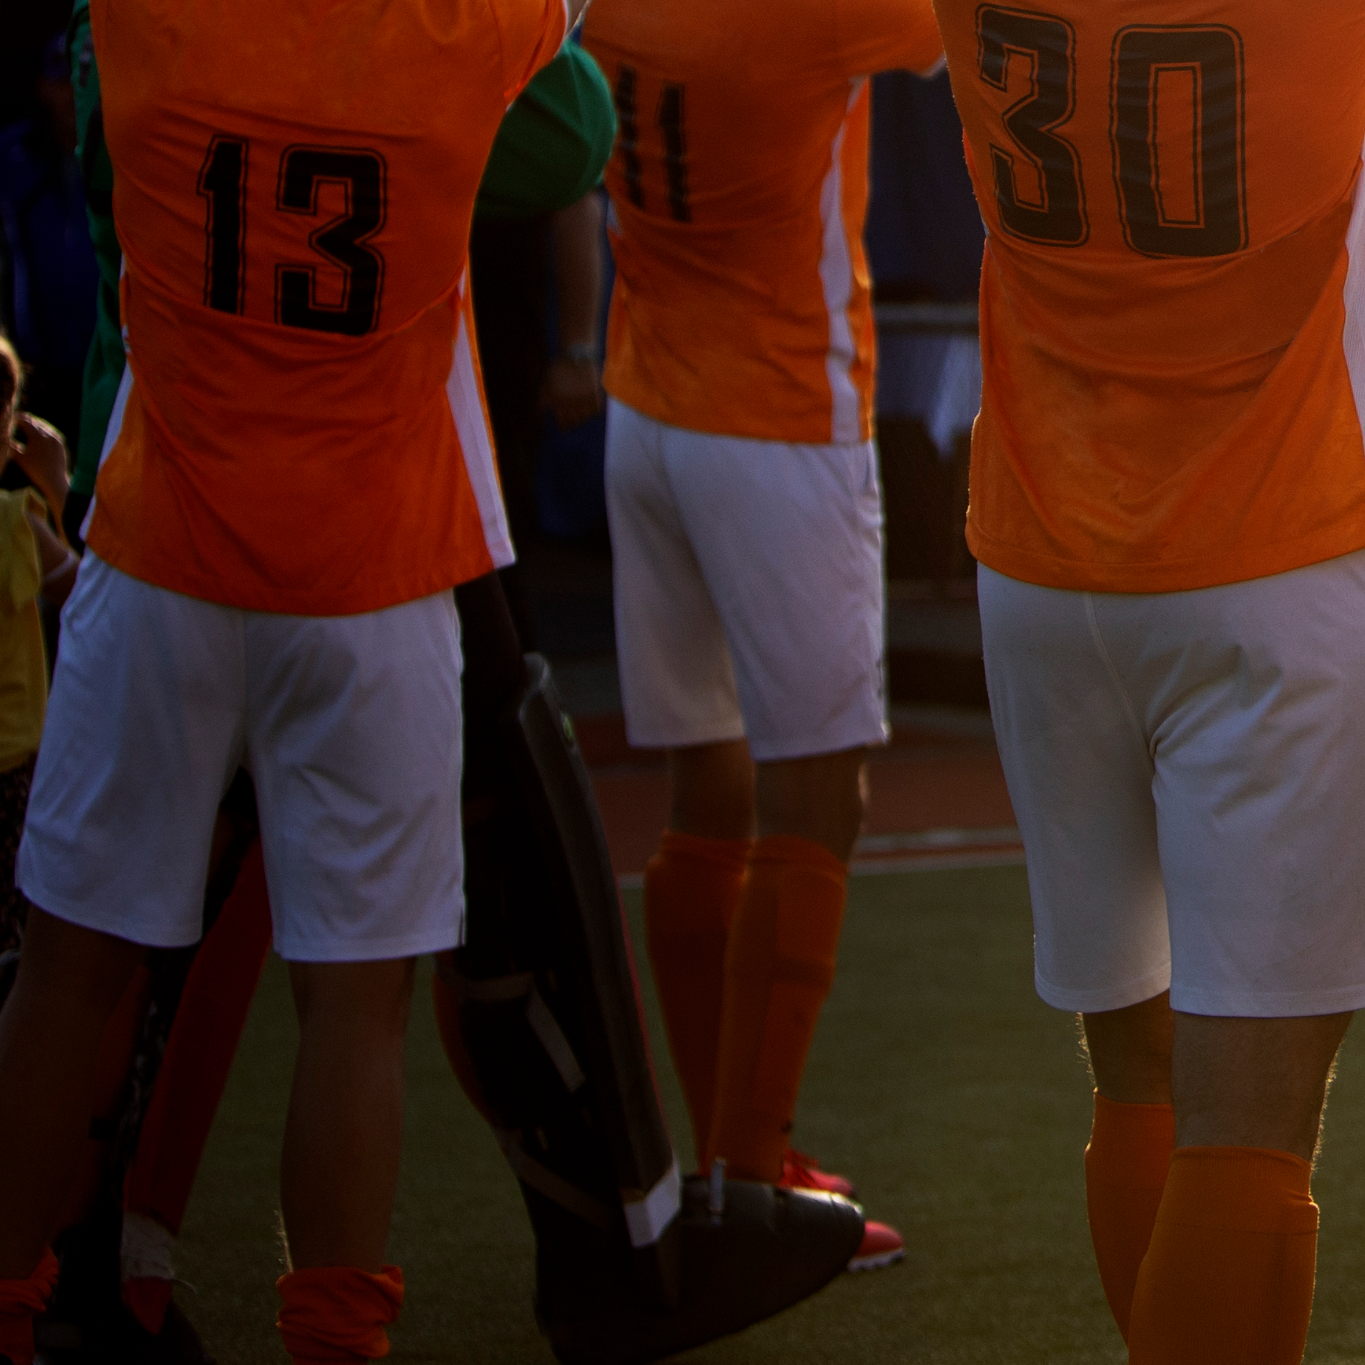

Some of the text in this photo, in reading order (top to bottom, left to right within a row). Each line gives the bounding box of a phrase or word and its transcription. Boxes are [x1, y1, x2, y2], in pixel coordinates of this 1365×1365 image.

[614, 60, 692, 222] 11
[976, 3, 1249, 259] 30
[197, 134, 387, 336] 13
